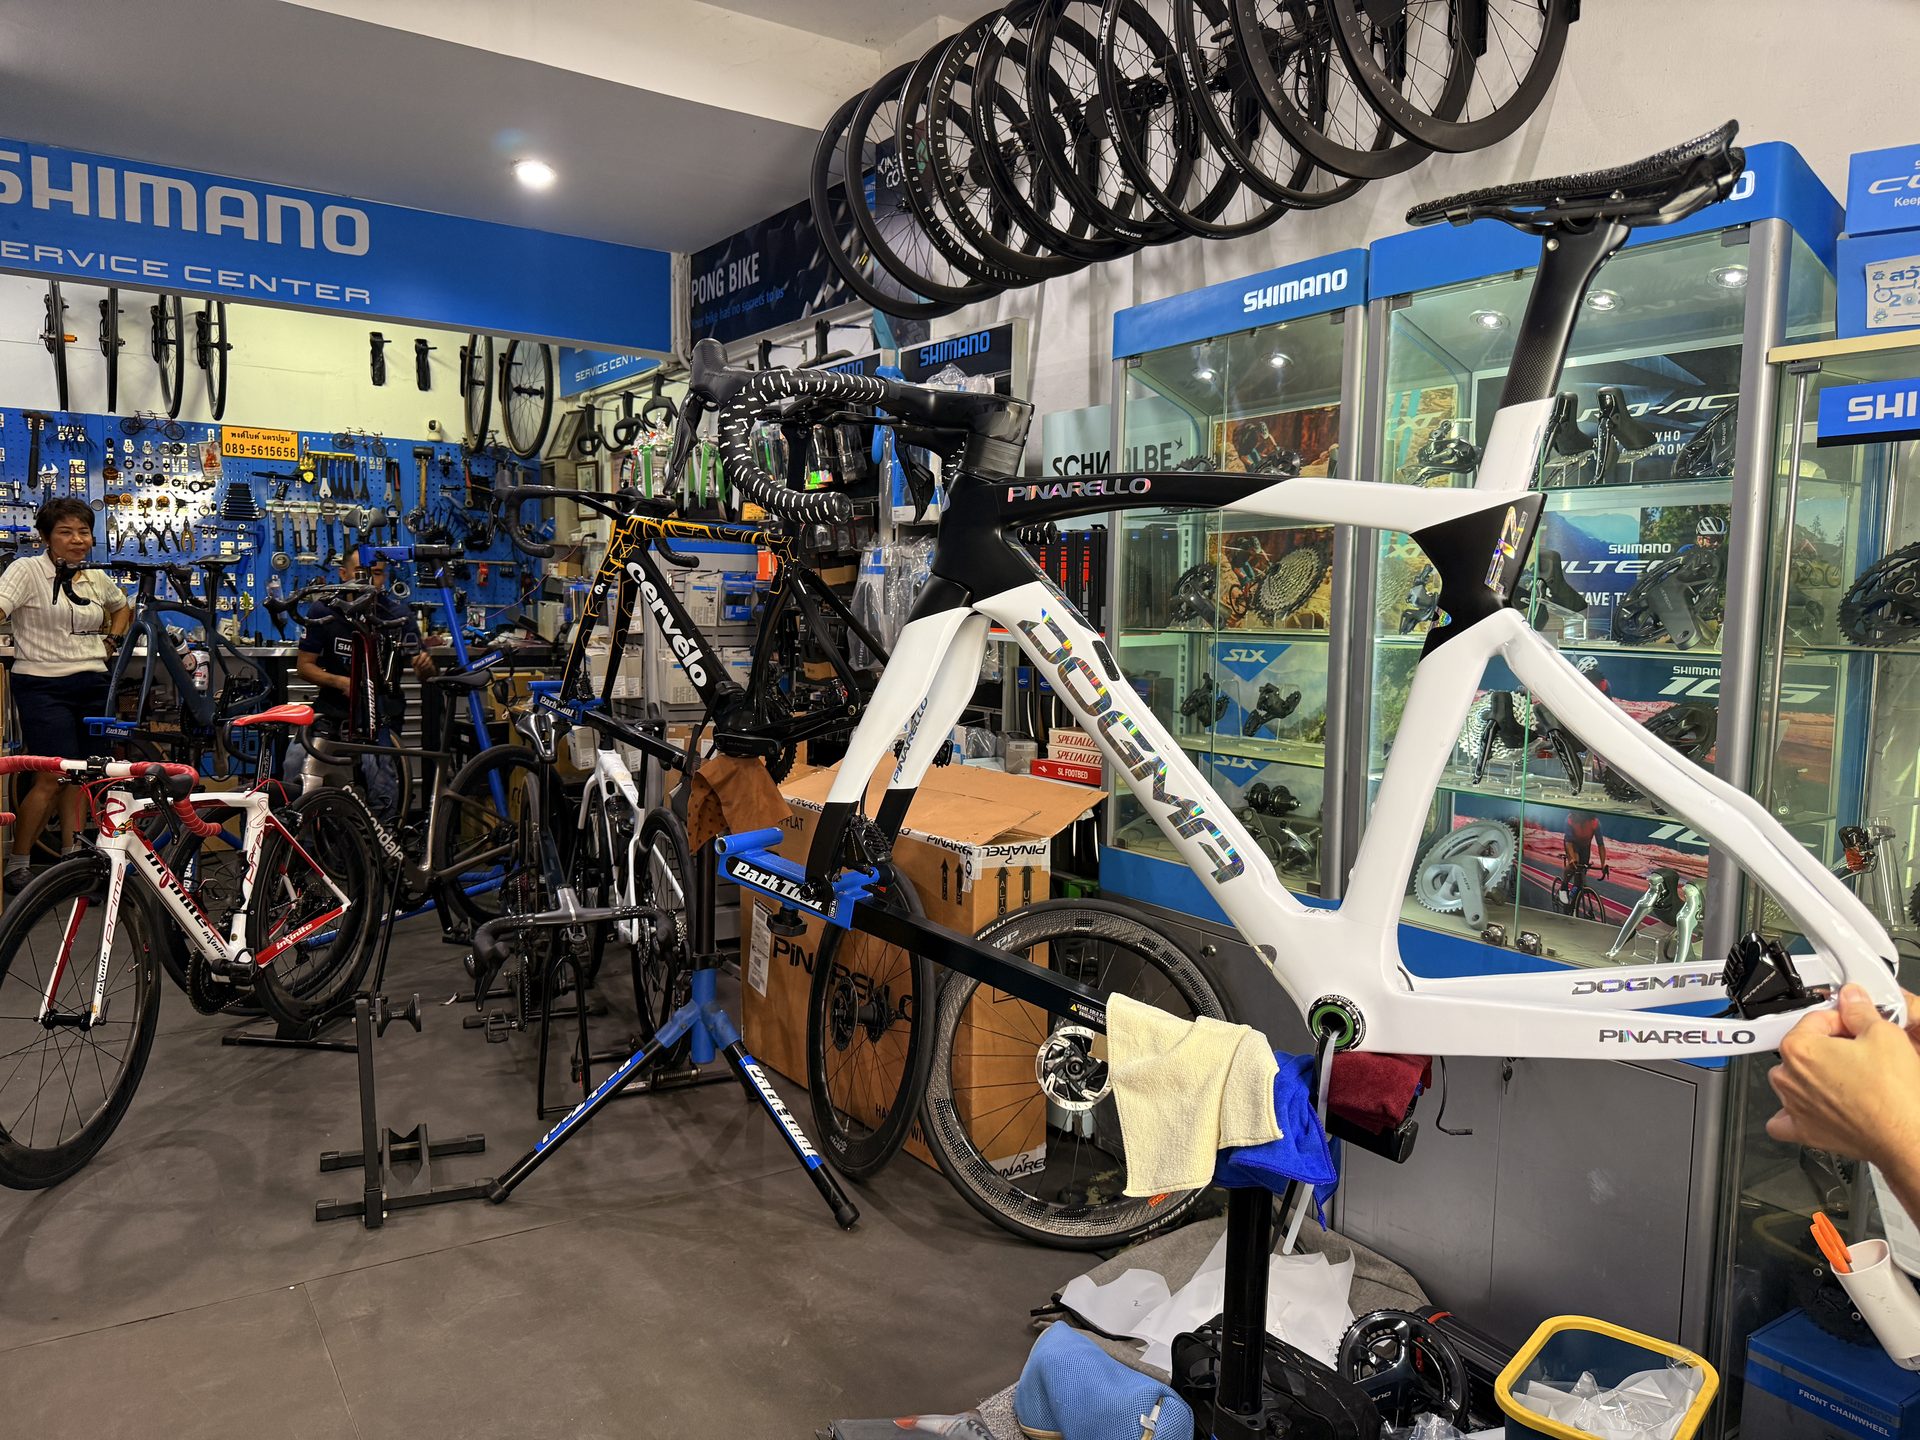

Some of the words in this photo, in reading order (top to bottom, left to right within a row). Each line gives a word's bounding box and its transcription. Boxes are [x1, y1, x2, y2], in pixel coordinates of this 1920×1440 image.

[906, 123, 923, 193] EDITION
[0, 240, 169, 279] ERVICE
[184, 265, 371, 305] CENTER
[691, 268, 725, 308] PONG
[729, 252, 760, 293] BIKE
[1243, 268, 1349, 313] SHIMANO
[919, 331, 991, 367] SHIMANO
[575, 362, 608, 382] SERVICE
[1847, 391, 1918, 422] SHI
[225, 443, 296, 458] 089-5615656
[1650, 444, 1686, 456] ROM
[1008, 477, 1152, 503] PINARELLO
[1608, 543, 1672, 554] SHIMANO
[626, 562, 708, 687] cervélo
[1222, 648, 1269, 664] SLX
[1672, 665, 1721, 676] SHIMAN
[893, 697, 928, 785] PINARELLO
[1016, 607, 1245, 885] DOGMA
[1056, 735, 1097, 748] SPECIALIZ
[1057, 767, 1064, 776] SL
[1065, 768, 1088, 779] FOOTBED
[732, 861, 779, 892] Park
[976, 918, 1007, 941] IRELLI
[1572, 973, 1706, 995] DOGMA
[1599, 1029, 1756, 1045] PINARELLO
[744, 1064, 790, 1115] Park
[1798, 1388, 1828, 1407] FRONT
[1829, 1403, 1891, 1438] CHAINWHEEL
